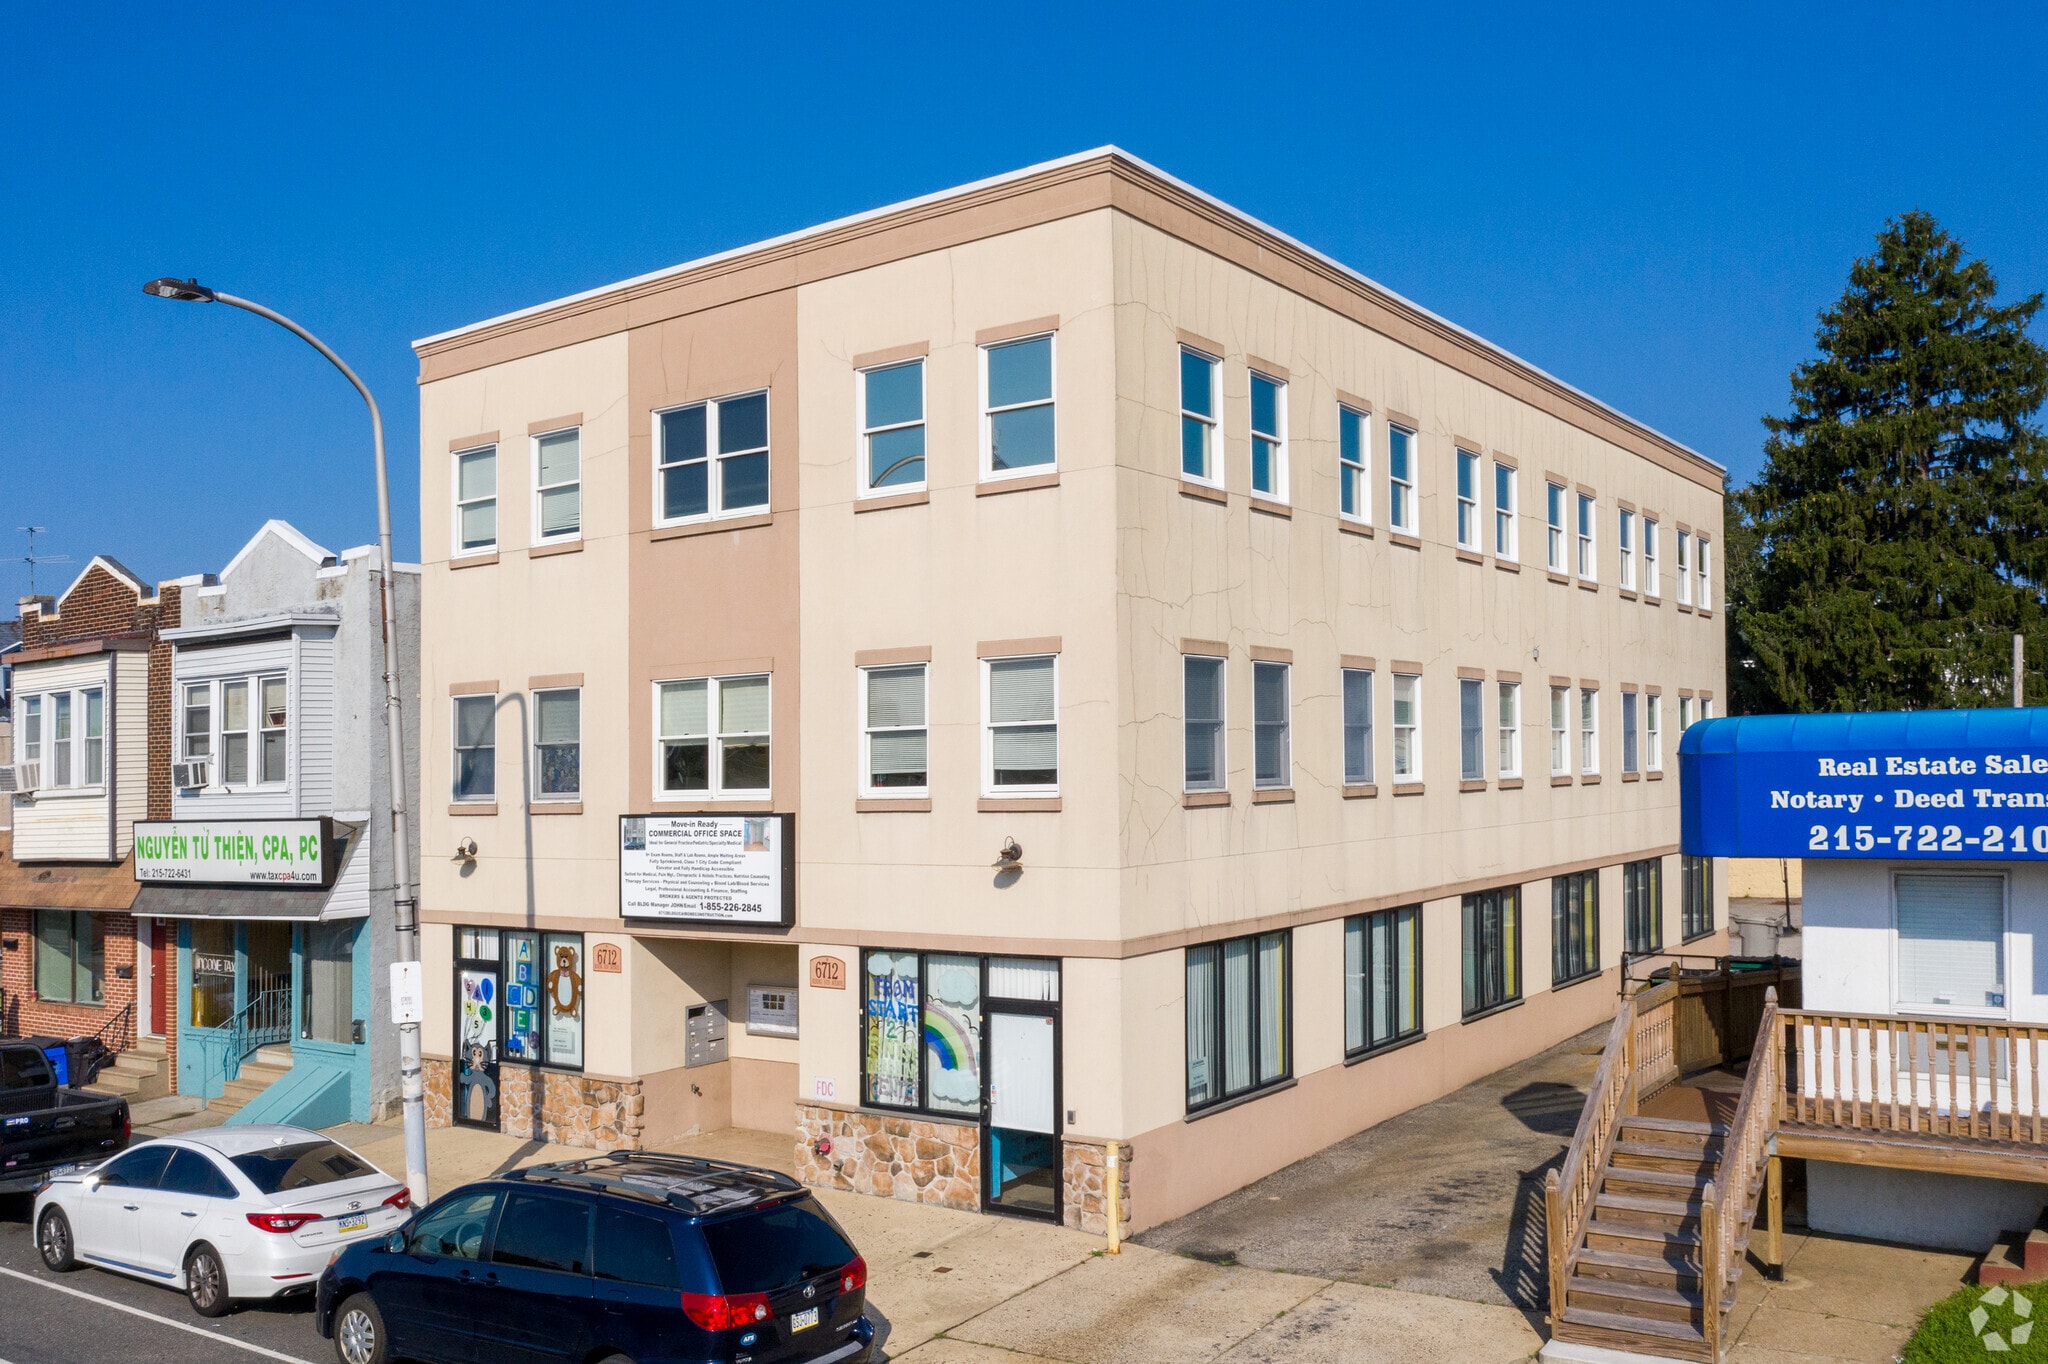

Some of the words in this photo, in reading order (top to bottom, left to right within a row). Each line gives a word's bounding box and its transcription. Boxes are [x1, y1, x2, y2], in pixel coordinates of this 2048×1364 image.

[1818, 757, 1878, 776] Real
[1886, 756, 1976, 776] Estate
[1985, 754, 2048, 774] Sale
[1771, 790, 1864, 812] Notary
[1894, 788, 1965, 808] Deed
[1973, 788, 2048, 808] Tran
[698, 820, 718, 829] Ready
[137, 826, 187, 859] NGUYỄN
[214, 830, 257, 867] THIỆN,
[262, 834, 292, 867] CPA,
[299, 834, 318, 861] PC
[140, 868, 150, 878] Tel:
[152, 868, 191, 878] 215-722-6431
[250, 871, 317, 884] www.taxcpa4u.com
[700, 902, 762, 912] 1-855-226-2845
[519, 942, 528, 958] A
[597, 949, 616, 965] 6712
[519, 964, 527, 981] B
[815, 961, 838, 980] 6712
[526, 988, 535, 1005] D
[874, 978, 914, 998] FROM
[518, 1010, 526, 1027] E
[868, 999, 919, 1022] START
[887, 1021, 897, 1038] 2
[817, 1081, 833, 1096] FDC
